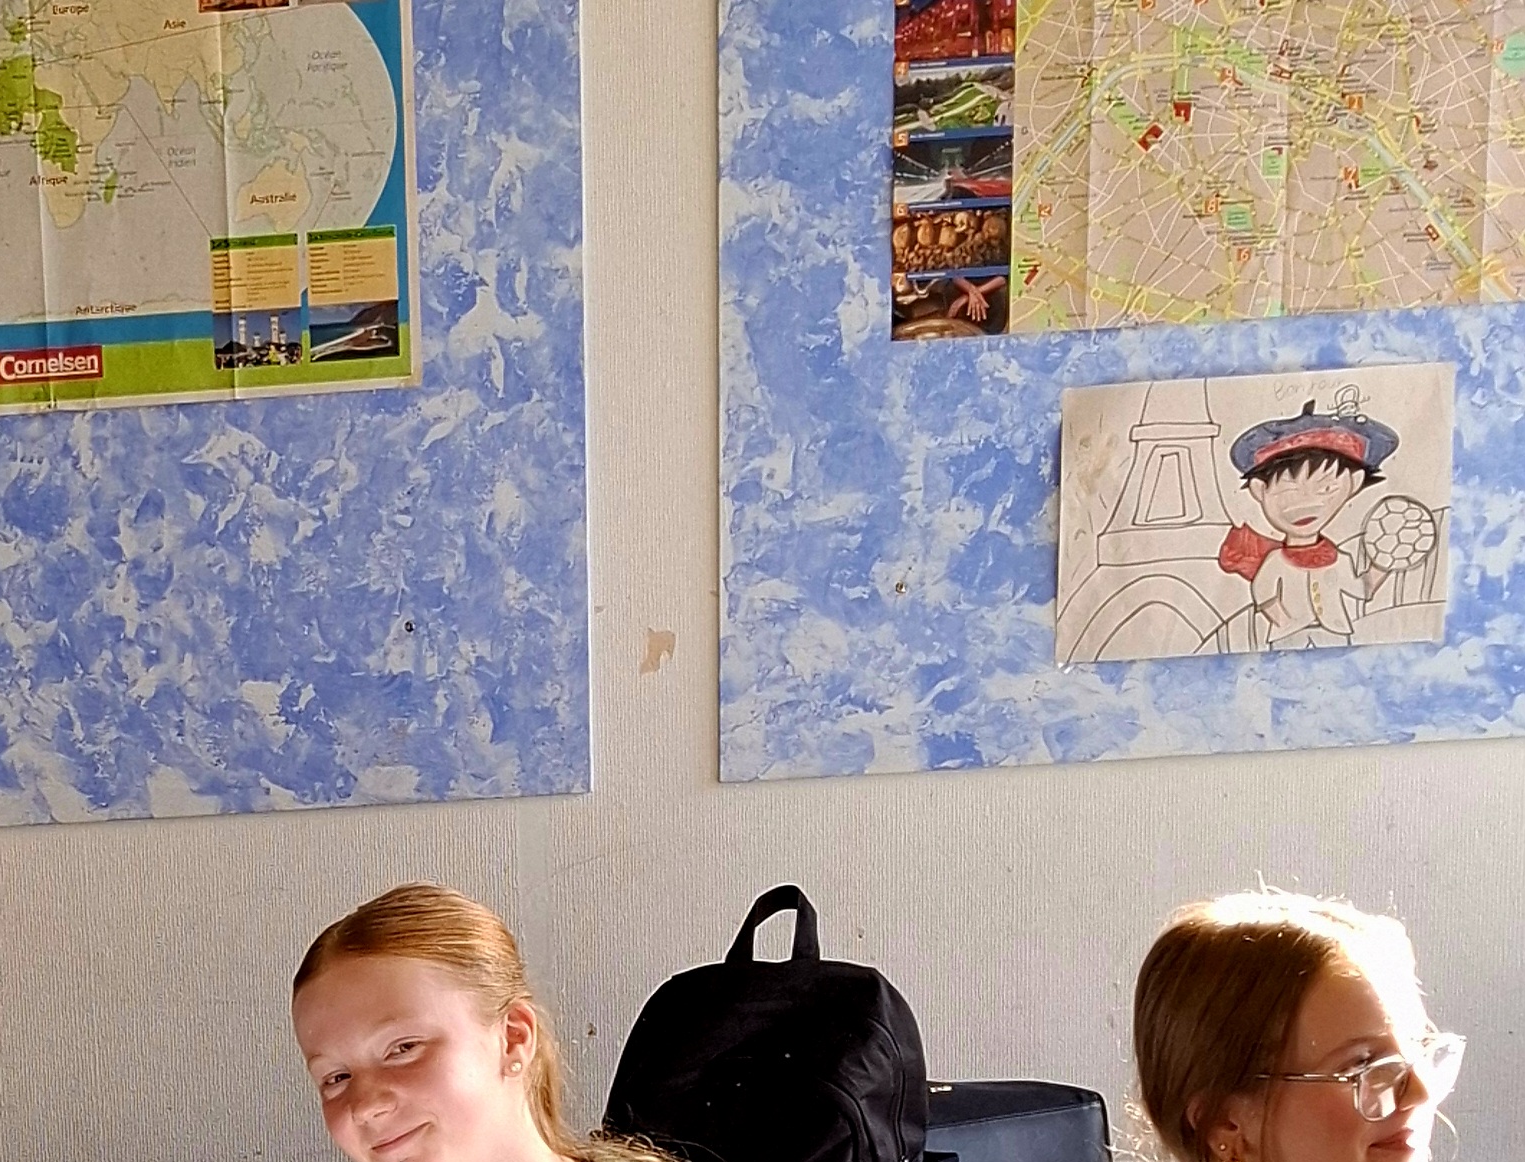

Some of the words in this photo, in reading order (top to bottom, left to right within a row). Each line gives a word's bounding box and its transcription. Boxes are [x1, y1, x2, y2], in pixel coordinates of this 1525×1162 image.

[52, 4, 90, 16] Europe
[163, 19, 187, 30] Asie
[0, 352, 100, 380] Cornelsen
